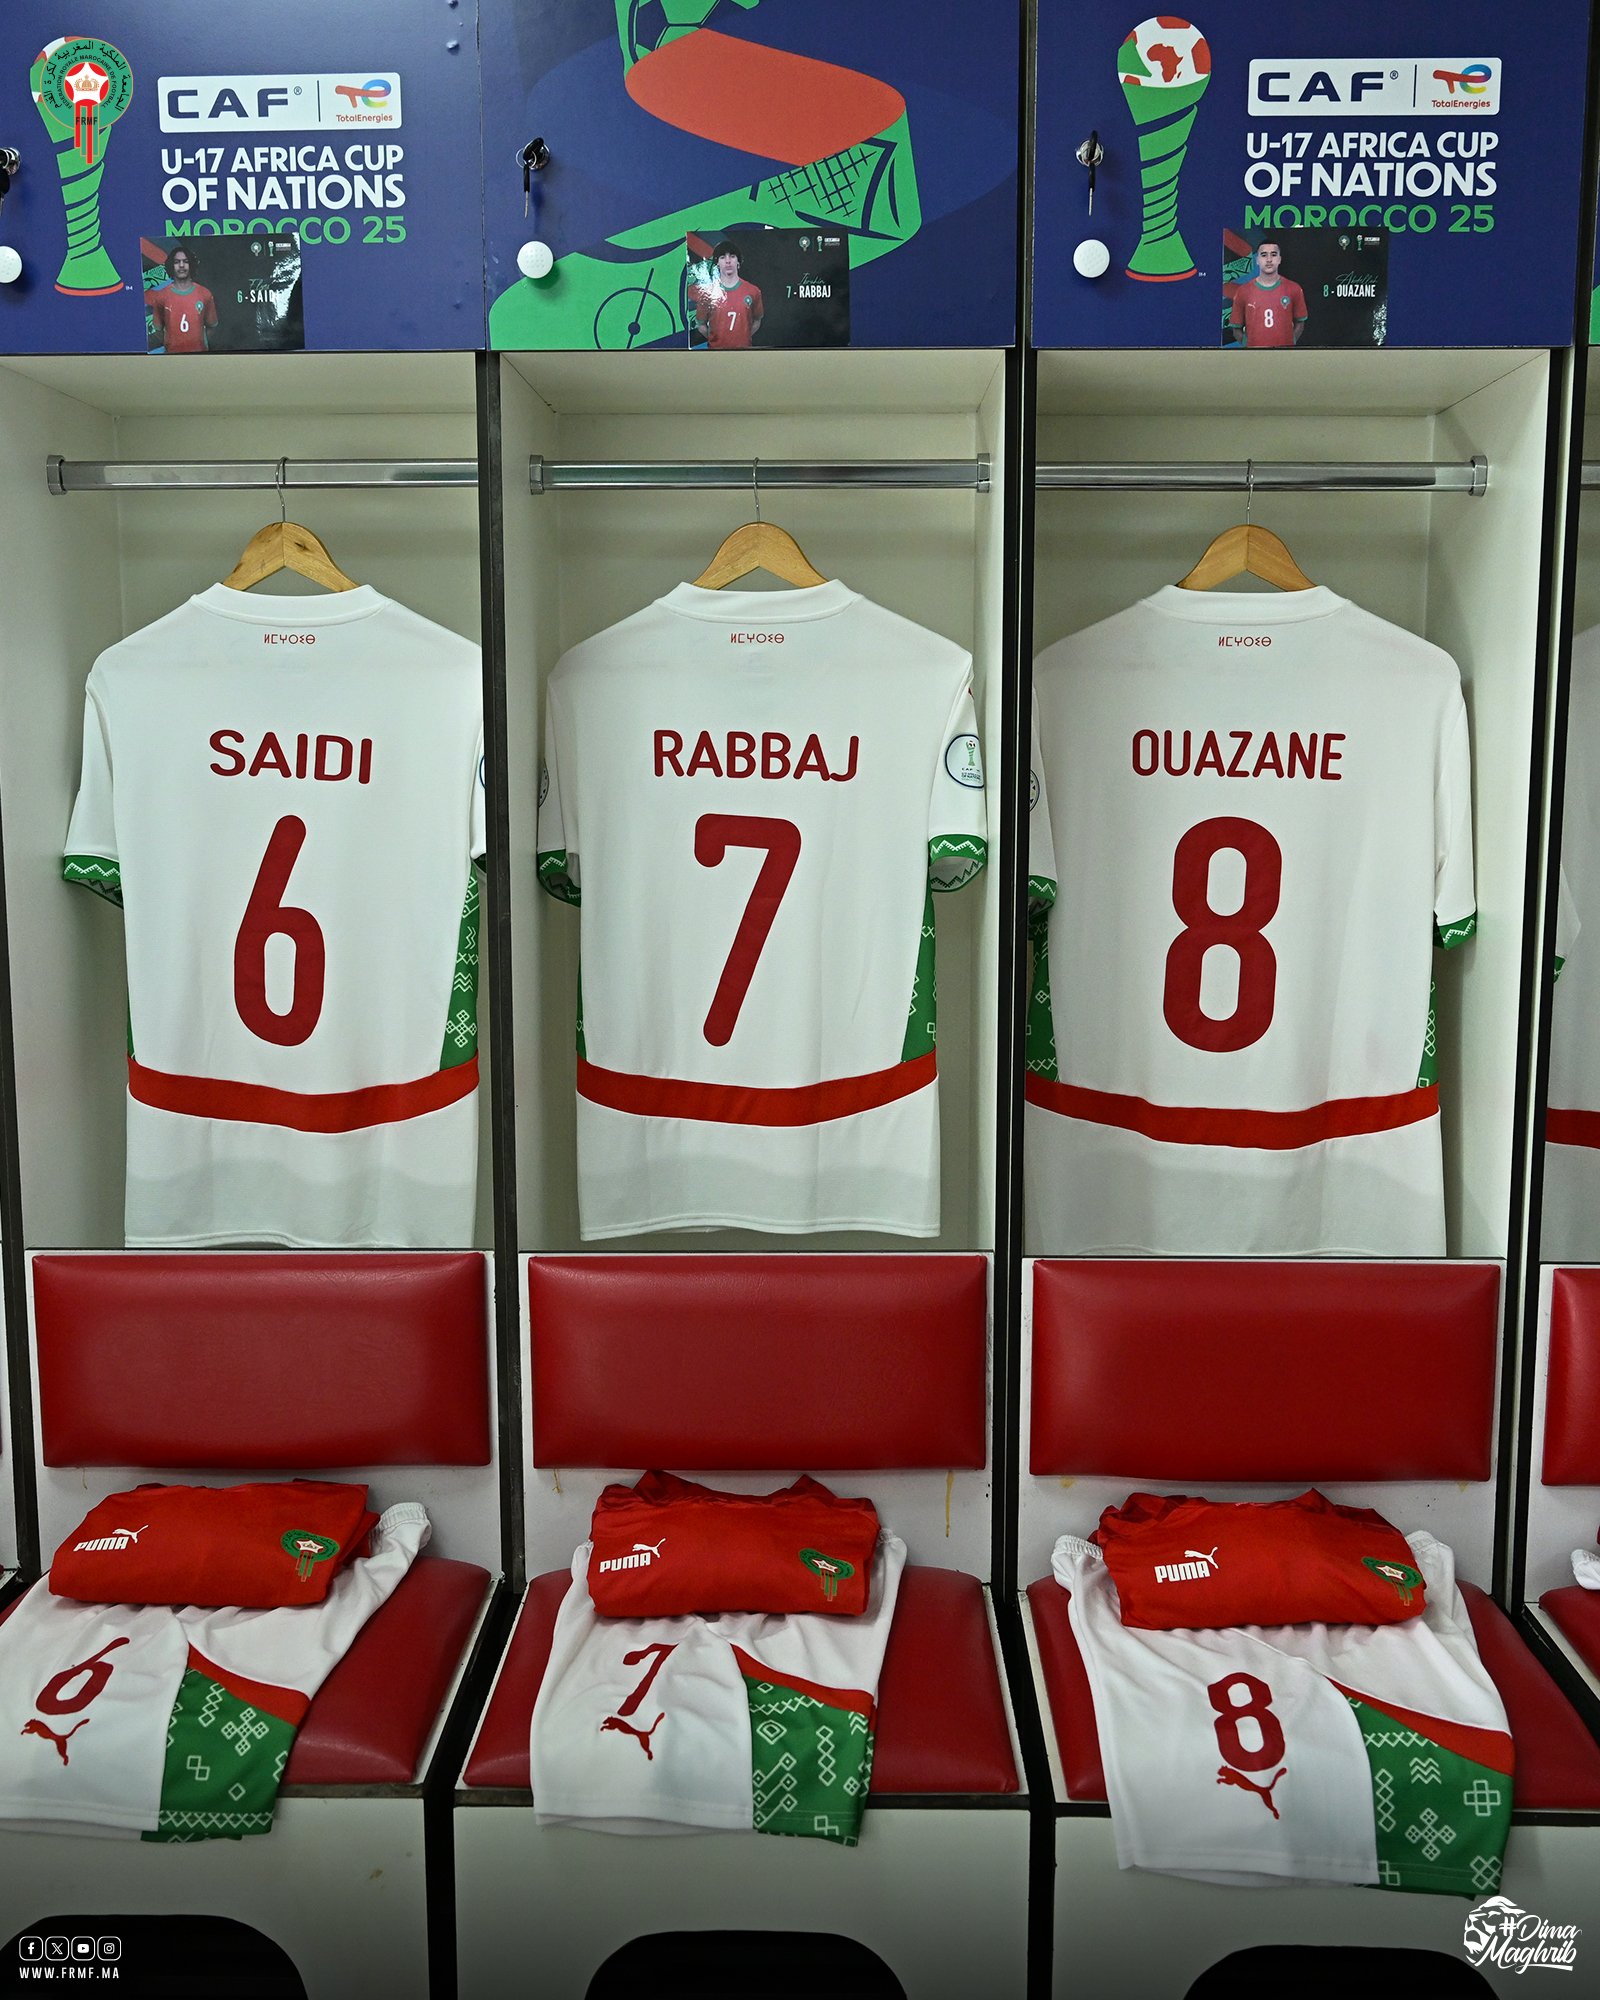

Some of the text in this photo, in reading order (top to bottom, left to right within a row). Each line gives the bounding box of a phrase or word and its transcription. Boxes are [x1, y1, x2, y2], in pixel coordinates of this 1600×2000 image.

[335, 113, 393, 124] TotalEnergies
[1431, 99, 1491, 110] TotalEnergies
[160, 144, 404, 174] U-17 AFRICA CUP
[1246, 131, 1499, 159] U-17 AFRICA CUP
[161, 173, 406, 212] OF NATIONS
[1244, 161, 1497, 198] OF NATIONS
[362, 215, 407, 244] 25
[1244, 204, 1495, 233] MOROCCO 25
[237, 290, 243, 303] 6
[786, 286, 792, 299] 7
[799, 285, 831, 298] RABBAJ
[1323, 285, 1329, 298] 8
[1336, 284, 1376, 298] OUAZANE
[180, 313, 189, 332] 6
[727, 311, 737, 331] 7
[1264, 308, 1274, 328] 8
[209, 729, 373, 784] SAIDI
[653, 729, 859, 782] RABBAJ
[1132, 729, 1346, 780] OUAZANE
[234, 814, 326, 1047] 6
[694, 813, 802, 1047] 7
[1163, 816, 1283, 1053] 8
[73, 1535, 130, 1552] PUMA
[600, 1552, 651, 1573] PUMA
[1154, 1560, 1211, 1583] PUMA
[36, 1637, 130, 1715] 6
[617, 1643, 678, 1716] 7
[1207, 1672, 1286, 1772] 8
